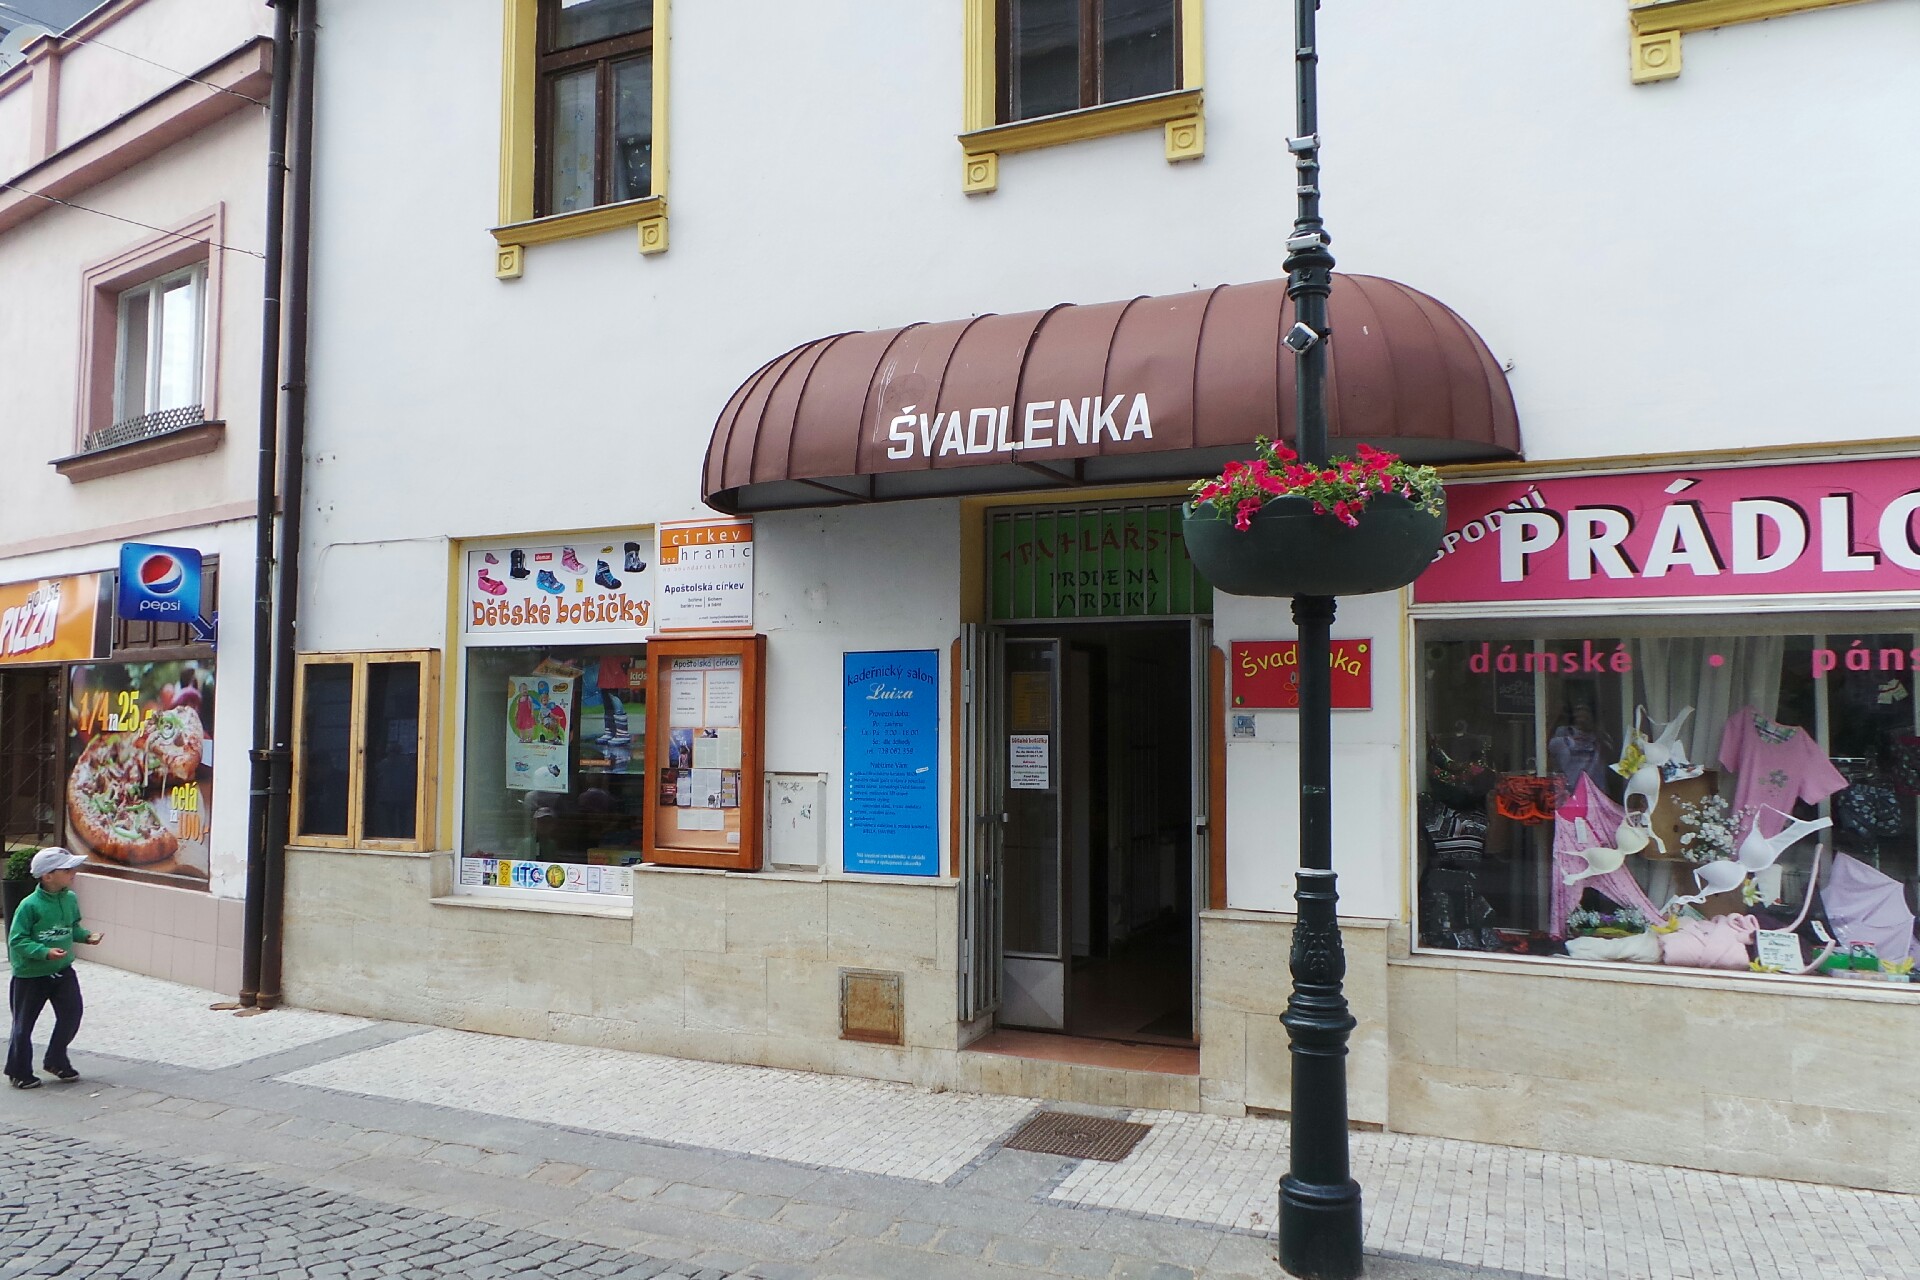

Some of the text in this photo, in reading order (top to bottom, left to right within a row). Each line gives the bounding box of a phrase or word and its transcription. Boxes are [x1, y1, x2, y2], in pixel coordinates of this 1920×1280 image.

[672, 529, 740, 545] církev
[682, 545, 750, 561] hranic
[664, 581, 744, 595] Apoštolská církev
[140, 600, 180, 612] pepsi
[472, 593, 651, 626] Dětské botičky
[0, 600, 59, 657] PIZZA
[673, 658, 738, 669] Apoštolská církev
[1470, 641, 1632, 674] dámské
[847, 664, 934, 687] kadeřnický salon
[866, 682, 914, 700] Luiza
[171, 781, 198, 812] celá
